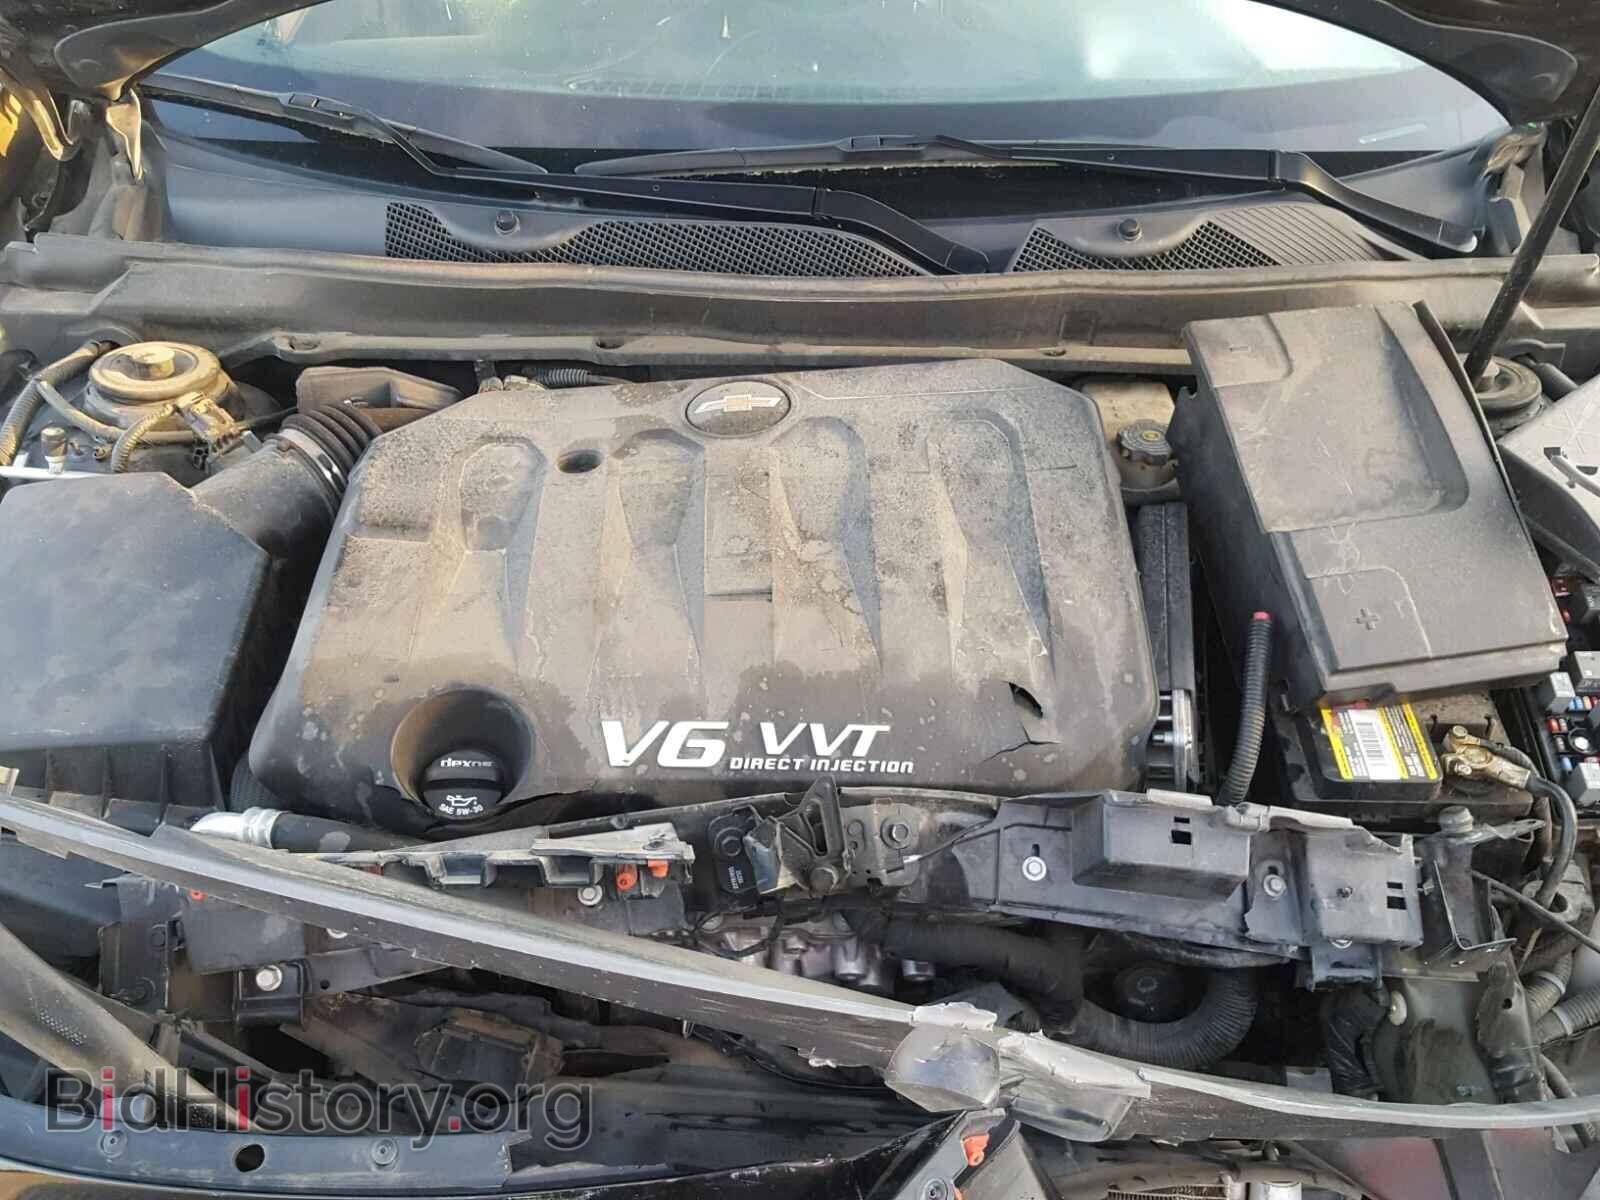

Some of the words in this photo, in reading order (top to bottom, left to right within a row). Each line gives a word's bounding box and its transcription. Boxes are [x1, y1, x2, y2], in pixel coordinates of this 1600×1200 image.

[601, 720, 729, 767] V6
[759, 722, 891, 757] VVT
[729, 757, 805, 771] DIRECT
[809, 759, 914, 774] INJECTION
